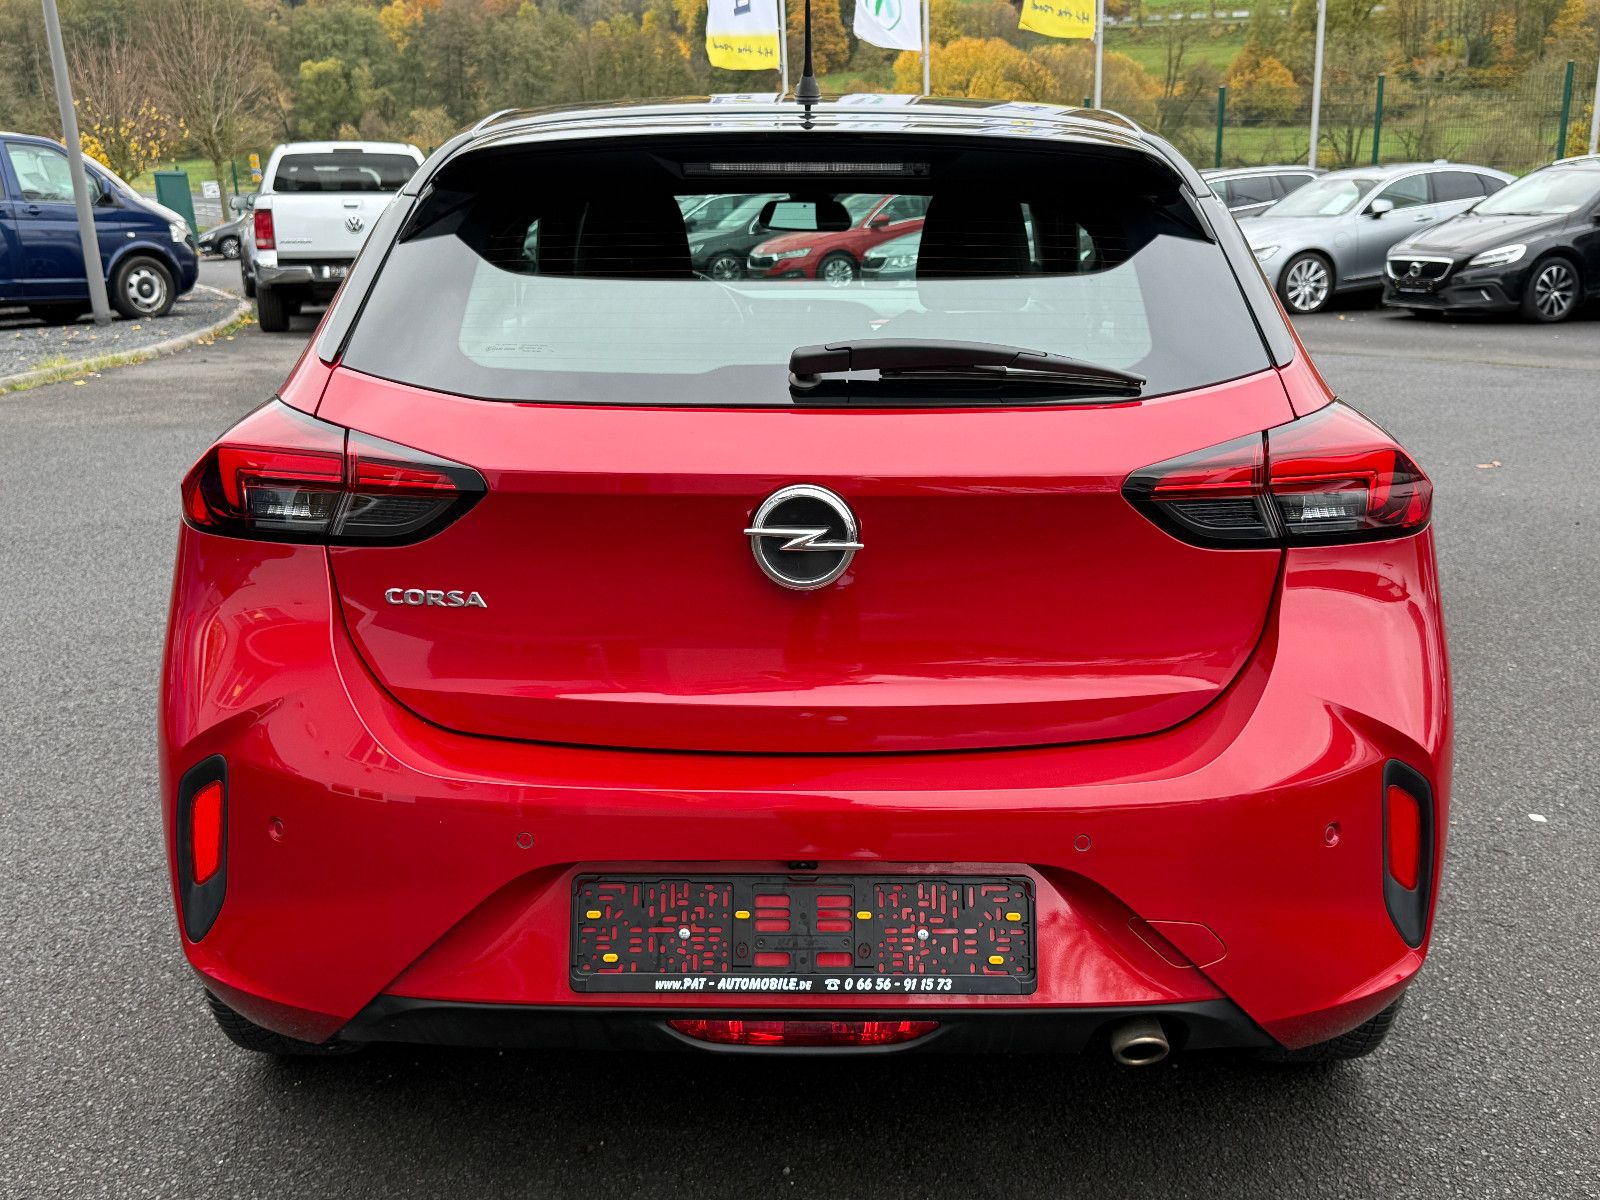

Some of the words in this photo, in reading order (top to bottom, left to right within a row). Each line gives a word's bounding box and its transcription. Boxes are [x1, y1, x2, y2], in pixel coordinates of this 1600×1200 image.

[385, 588, 488, 608] CORSA
[655, 977, 706, 990] www.PAT
[845, 977, 854, 991] 0
[857, 977, 873, 991] 66
[875, 977, 892, 991] 56
[904, 977, 918, 992] 91
[921, 978, 935, 991] 15
[937, 978, 953, 991] 73
